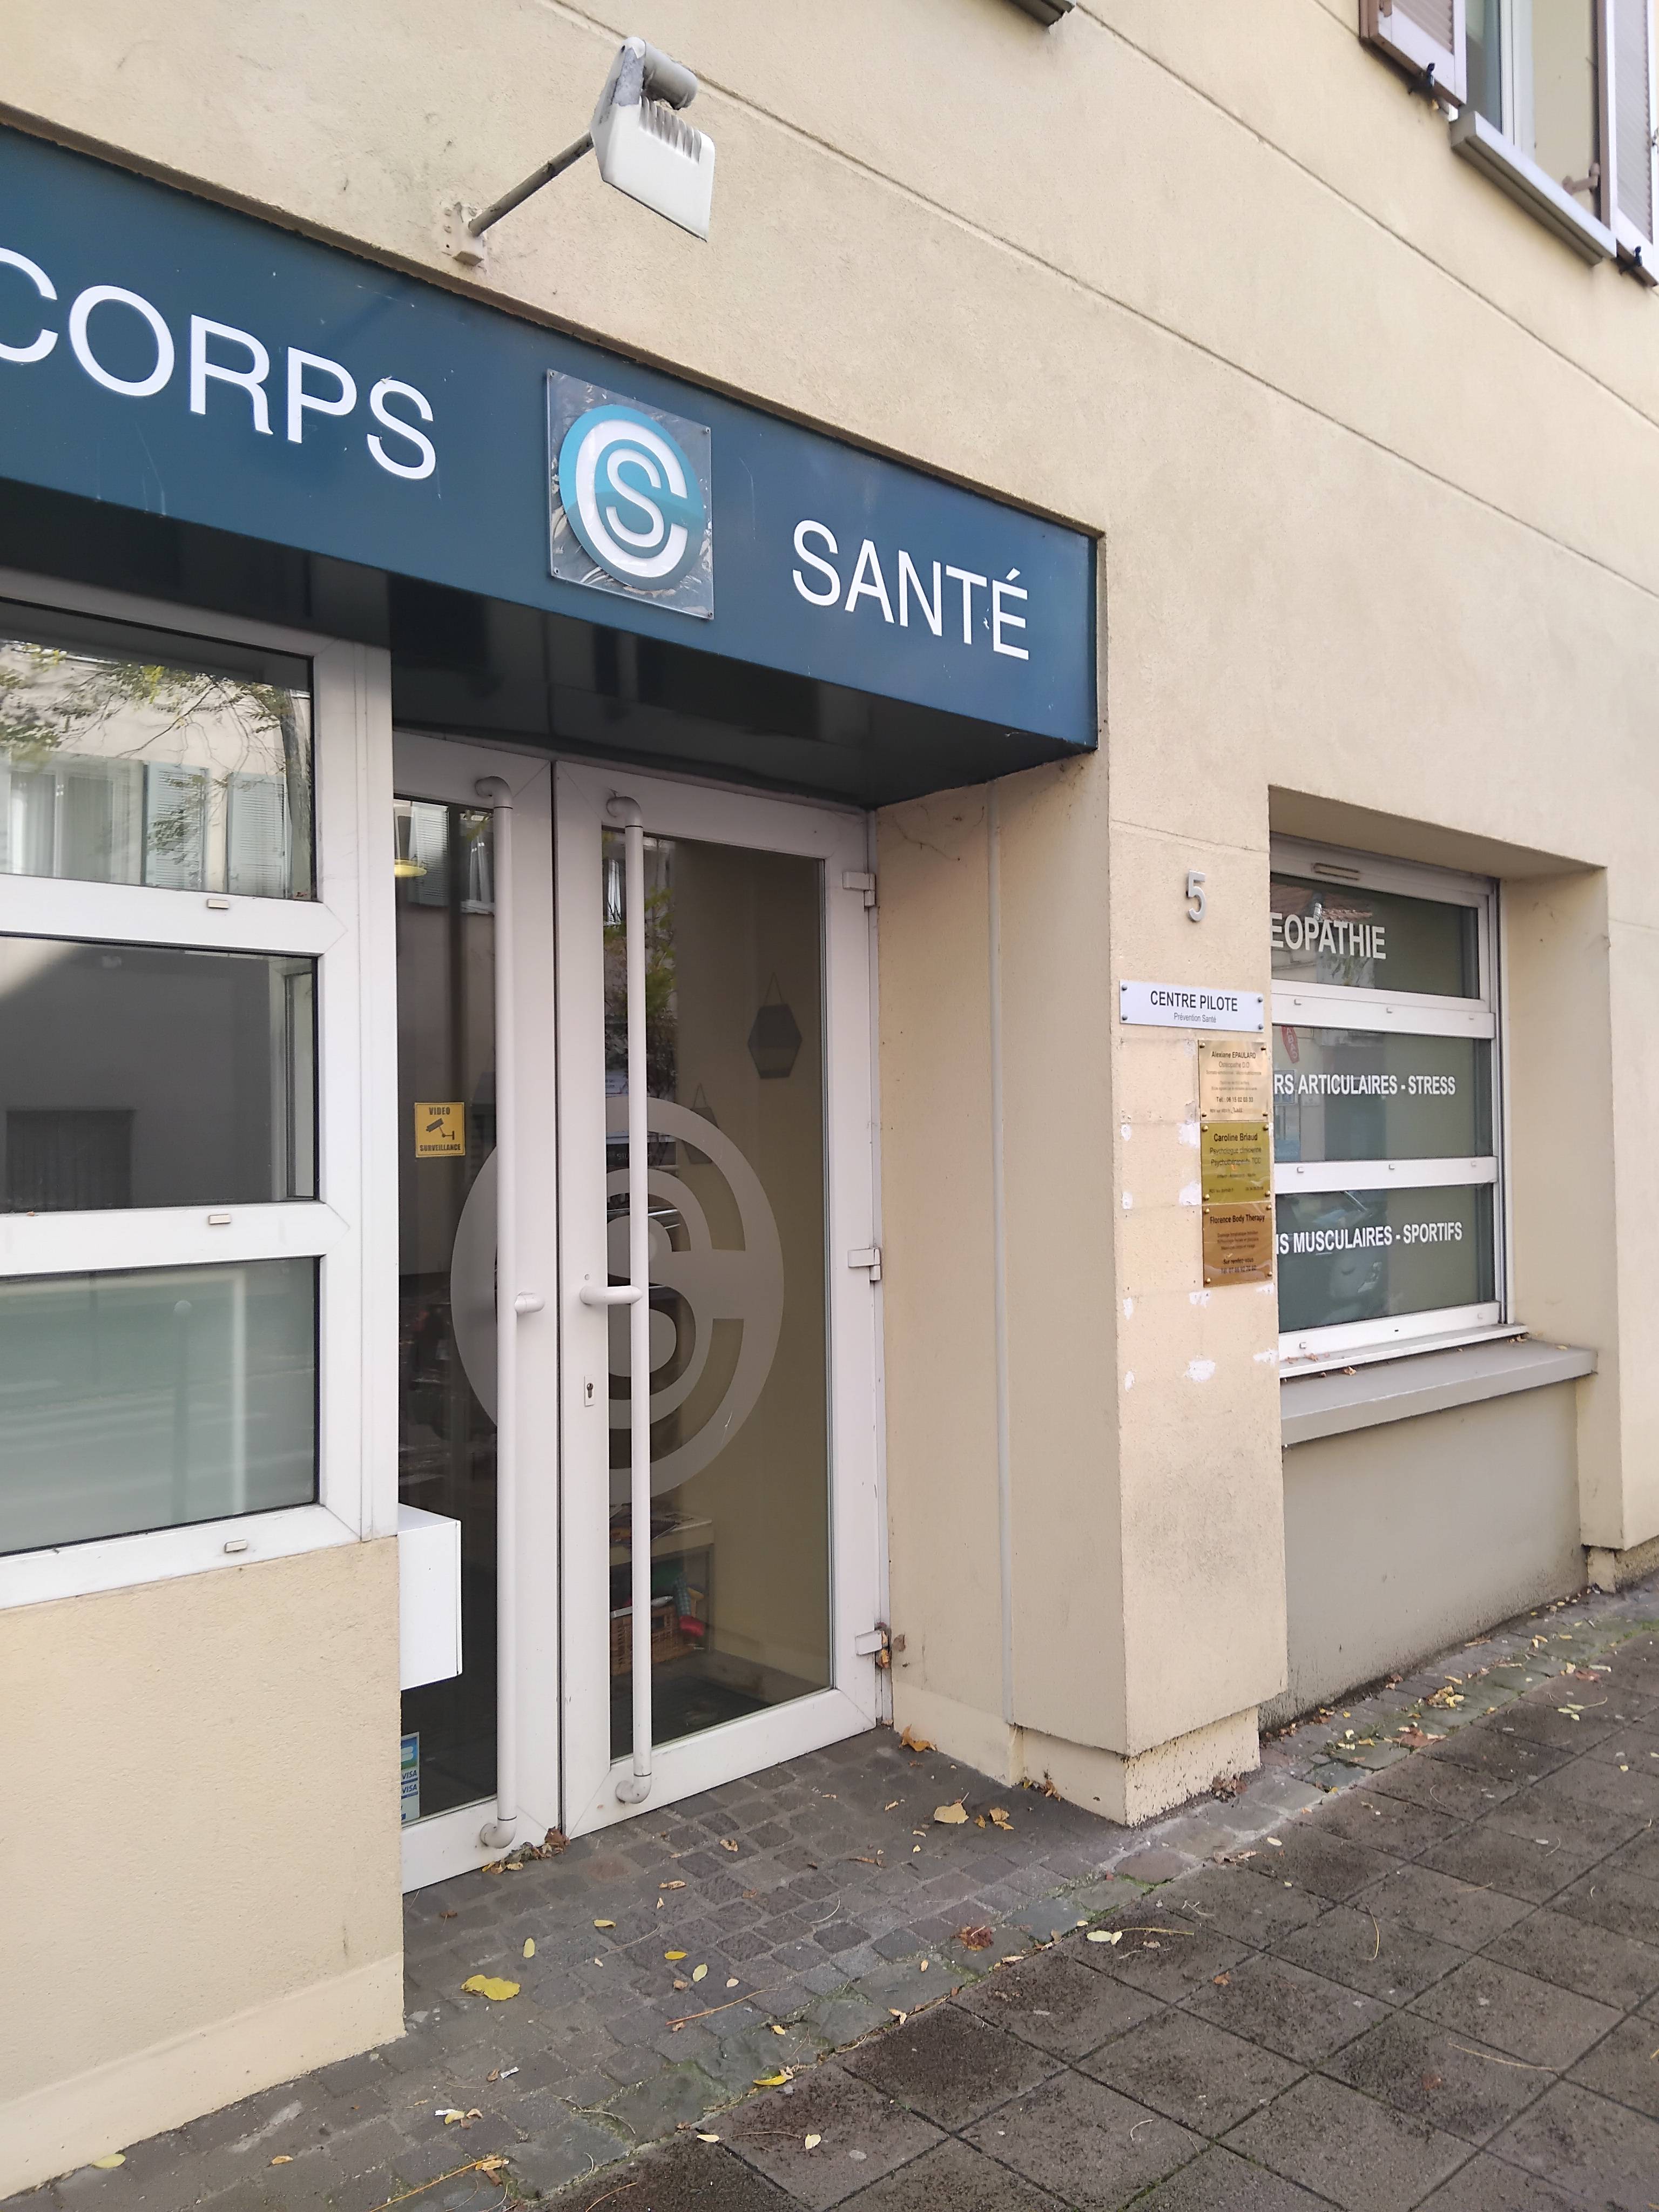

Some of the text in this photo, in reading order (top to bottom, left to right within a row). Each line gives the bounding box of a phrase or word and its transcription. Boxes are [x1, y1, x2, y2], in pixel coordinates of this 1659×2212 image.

[0, 247, 1029, 660] CORPS SANTÉ
[1188, 869, 1206, 921] 5
[1270, 912, 1386, 960] EOPATHIE
[1150, 990, 1238, 1011] CENTRE PILOTE
[1174, 1013, 1217, 1023] Prévention Santé
[1298, 1074, 1398, 1095] ARTICULAIRES
[1408, 1075, 1456, 1095] STRESS
[429, 1107, 450, 1115] VIDEO
[1213, 1132, 1258, 1142] Caroline Briaud
[1210, 1213, 1265, 1224] Florence Body Therapy
[1293, 1225, 1392, 1253] MUSCULAIRES
[1404, 1221, 1462, 1244] SPORTIFS
[402, 1770, 417, 1779] VISA
[402, 1784, 417, 1793] VISA
